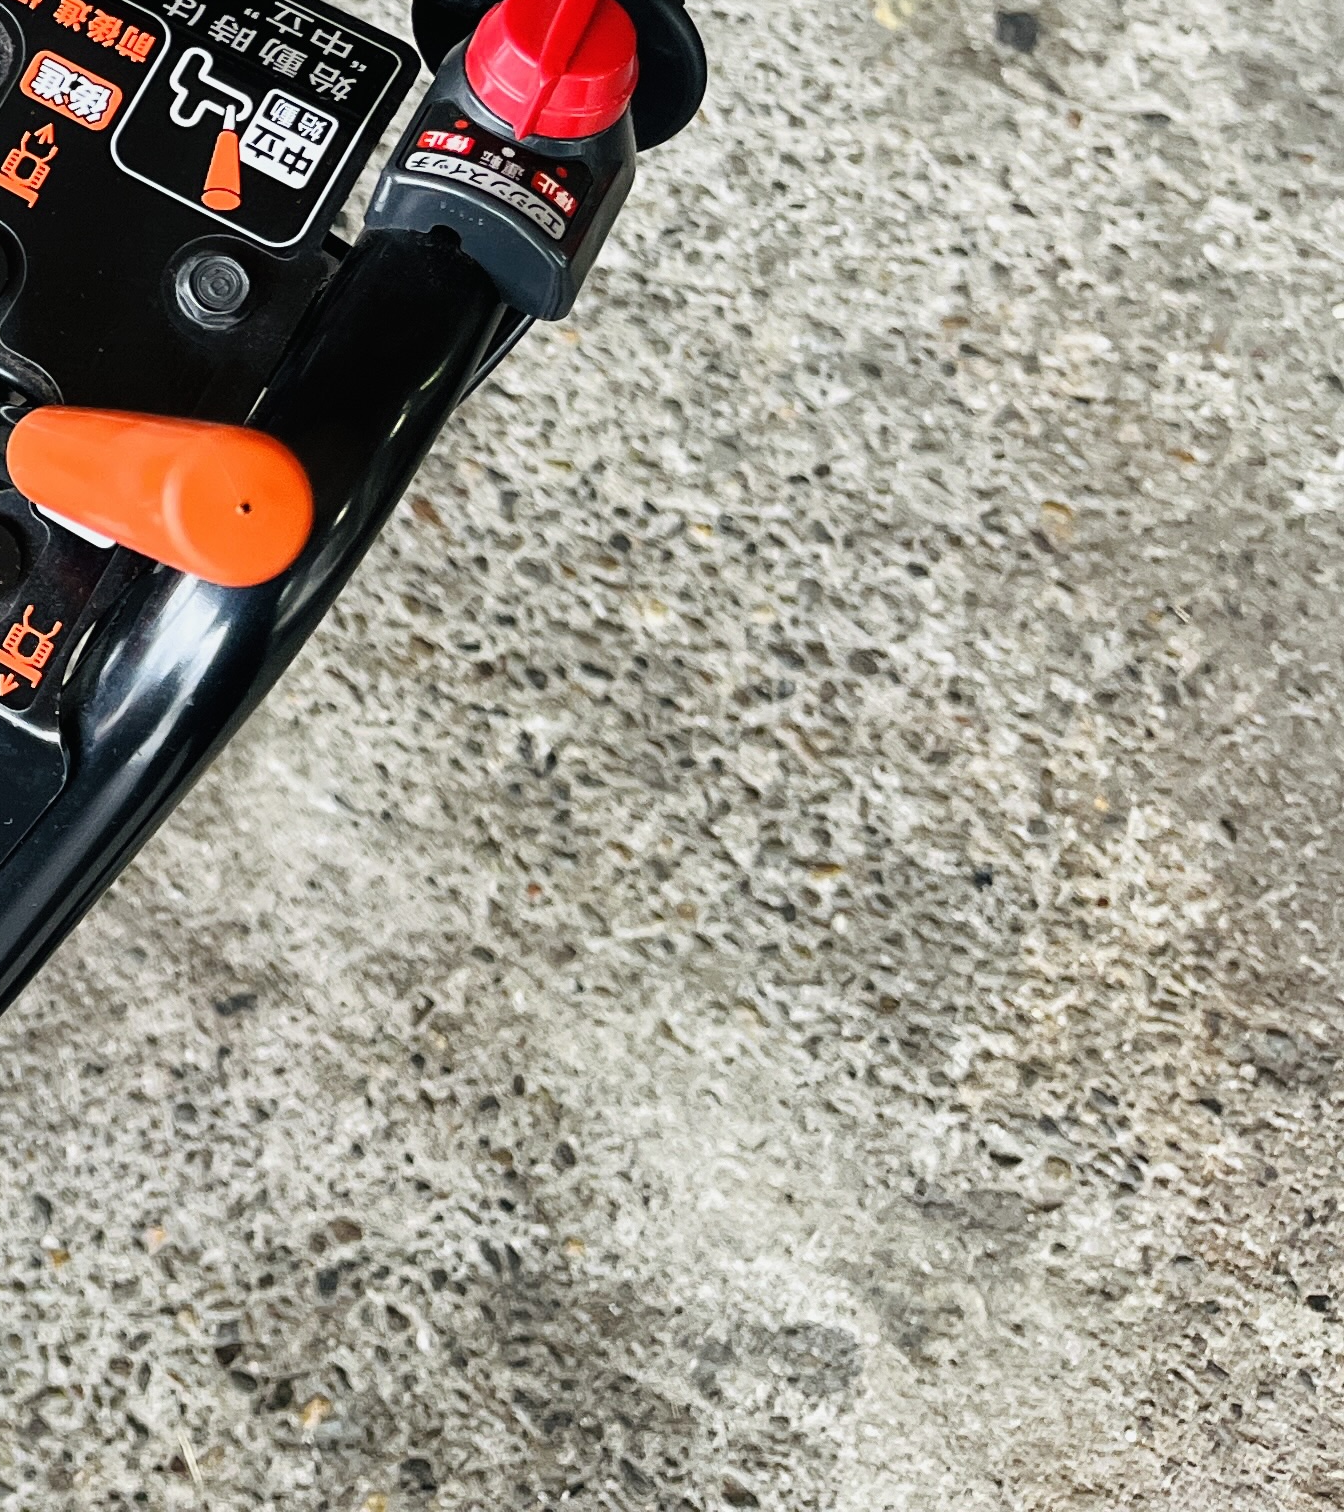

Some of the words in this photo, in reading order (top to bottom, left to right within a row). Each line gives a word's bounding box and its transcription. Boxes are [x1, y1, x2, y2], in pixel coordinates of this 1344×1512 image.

[30, 60, 112, 123] 後進
[269, 97, 326, 143] 始動
[420, 131, 470, 154] 停止
[244, 129, 314, 178] 中立
[479, 150, 524, 181] 運転
[406, 154, 563, 233] エンジンスイッチ
[534, 172, 577, 214] 停止
